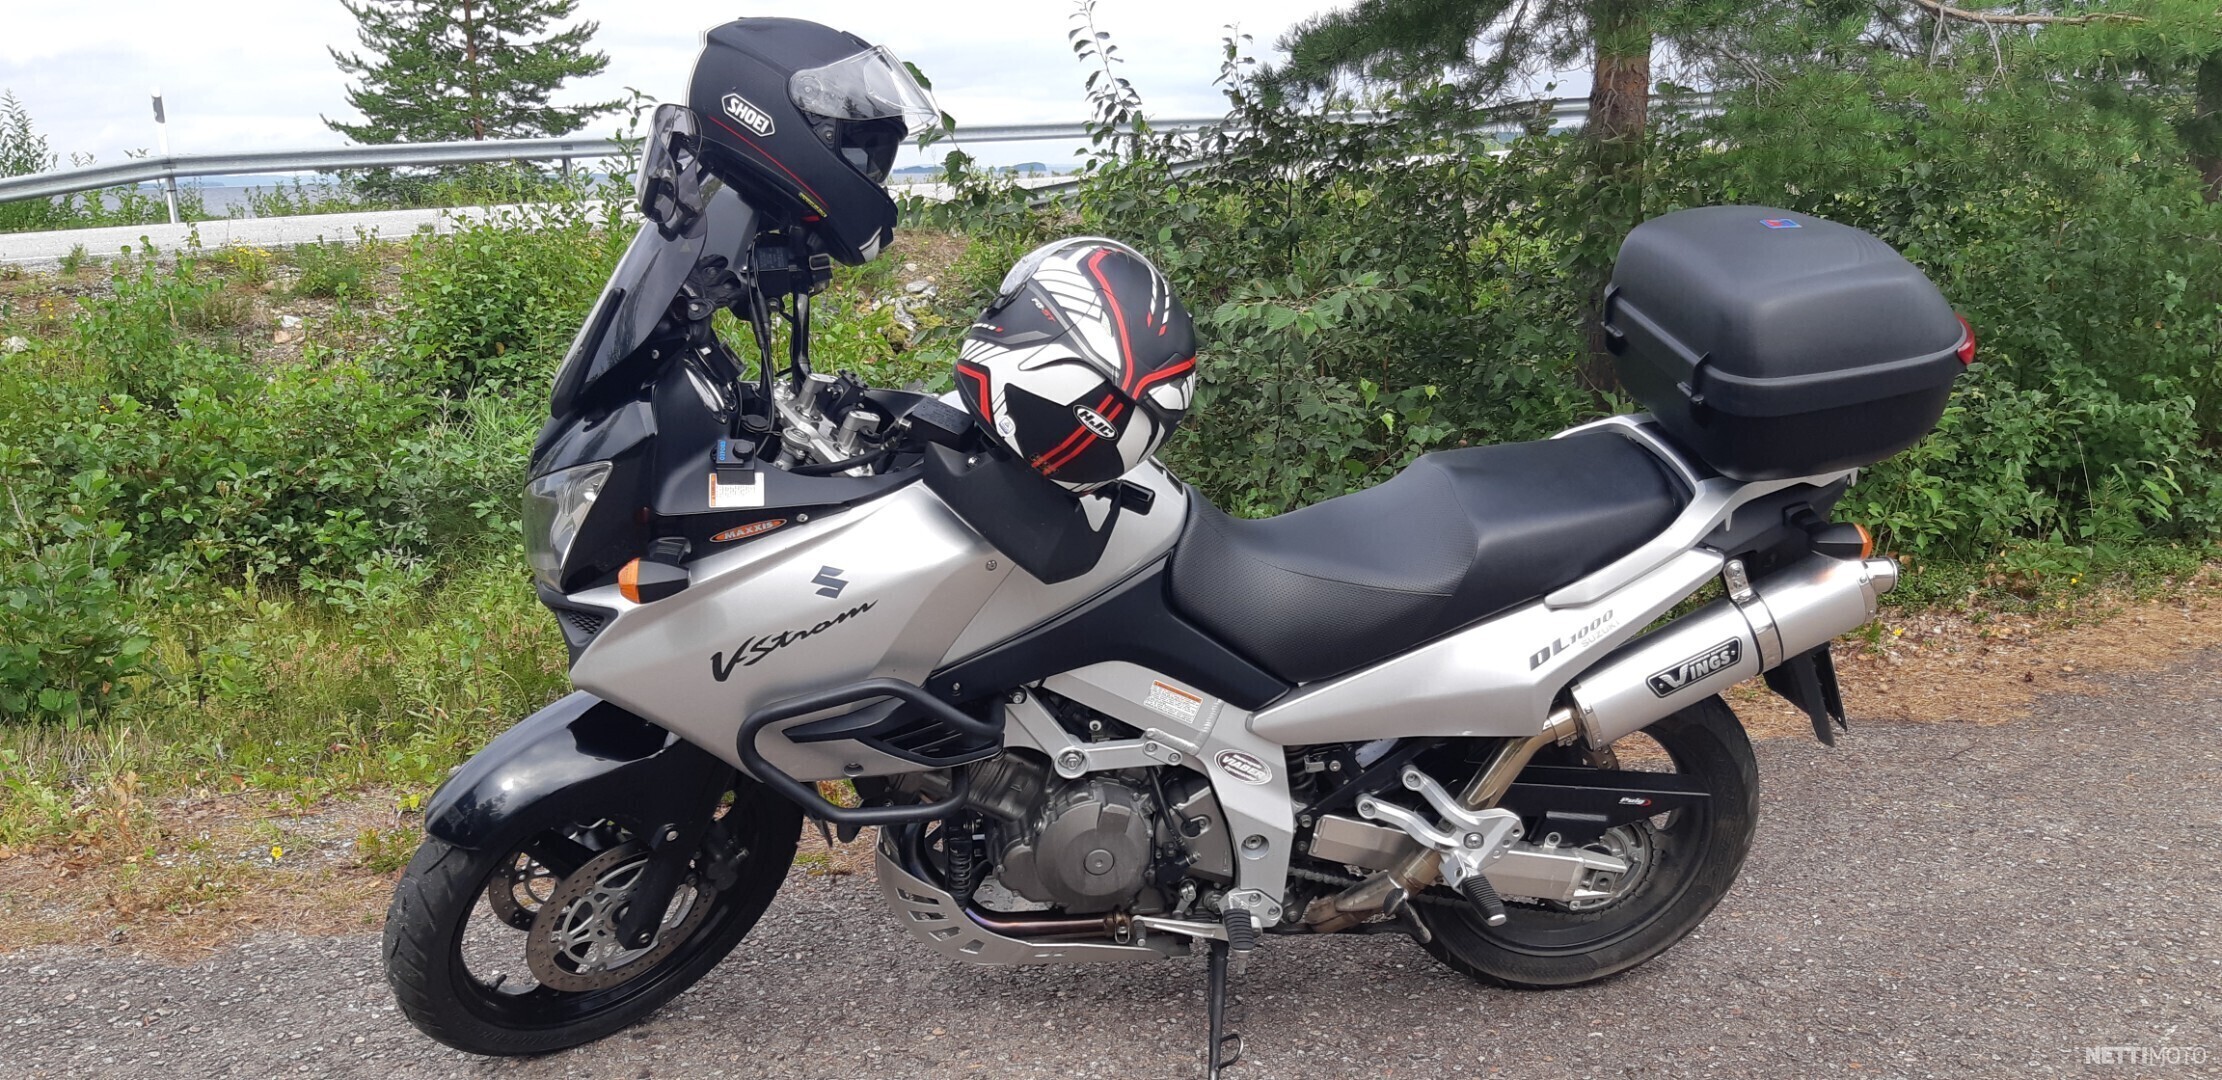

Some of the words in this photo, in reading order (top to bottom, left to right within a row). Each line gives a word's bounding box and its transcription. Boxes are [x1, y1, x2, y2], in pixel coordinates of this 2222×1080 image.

[727, 98, 769, 133] SHOEI
[1078, 410, 1115, 436] HJC
[724, 521, 774, 539] MAXXIS
[1581, 620, 1620, 647] SUZUKI
[1659, 650, 1731, 688] WINGS
